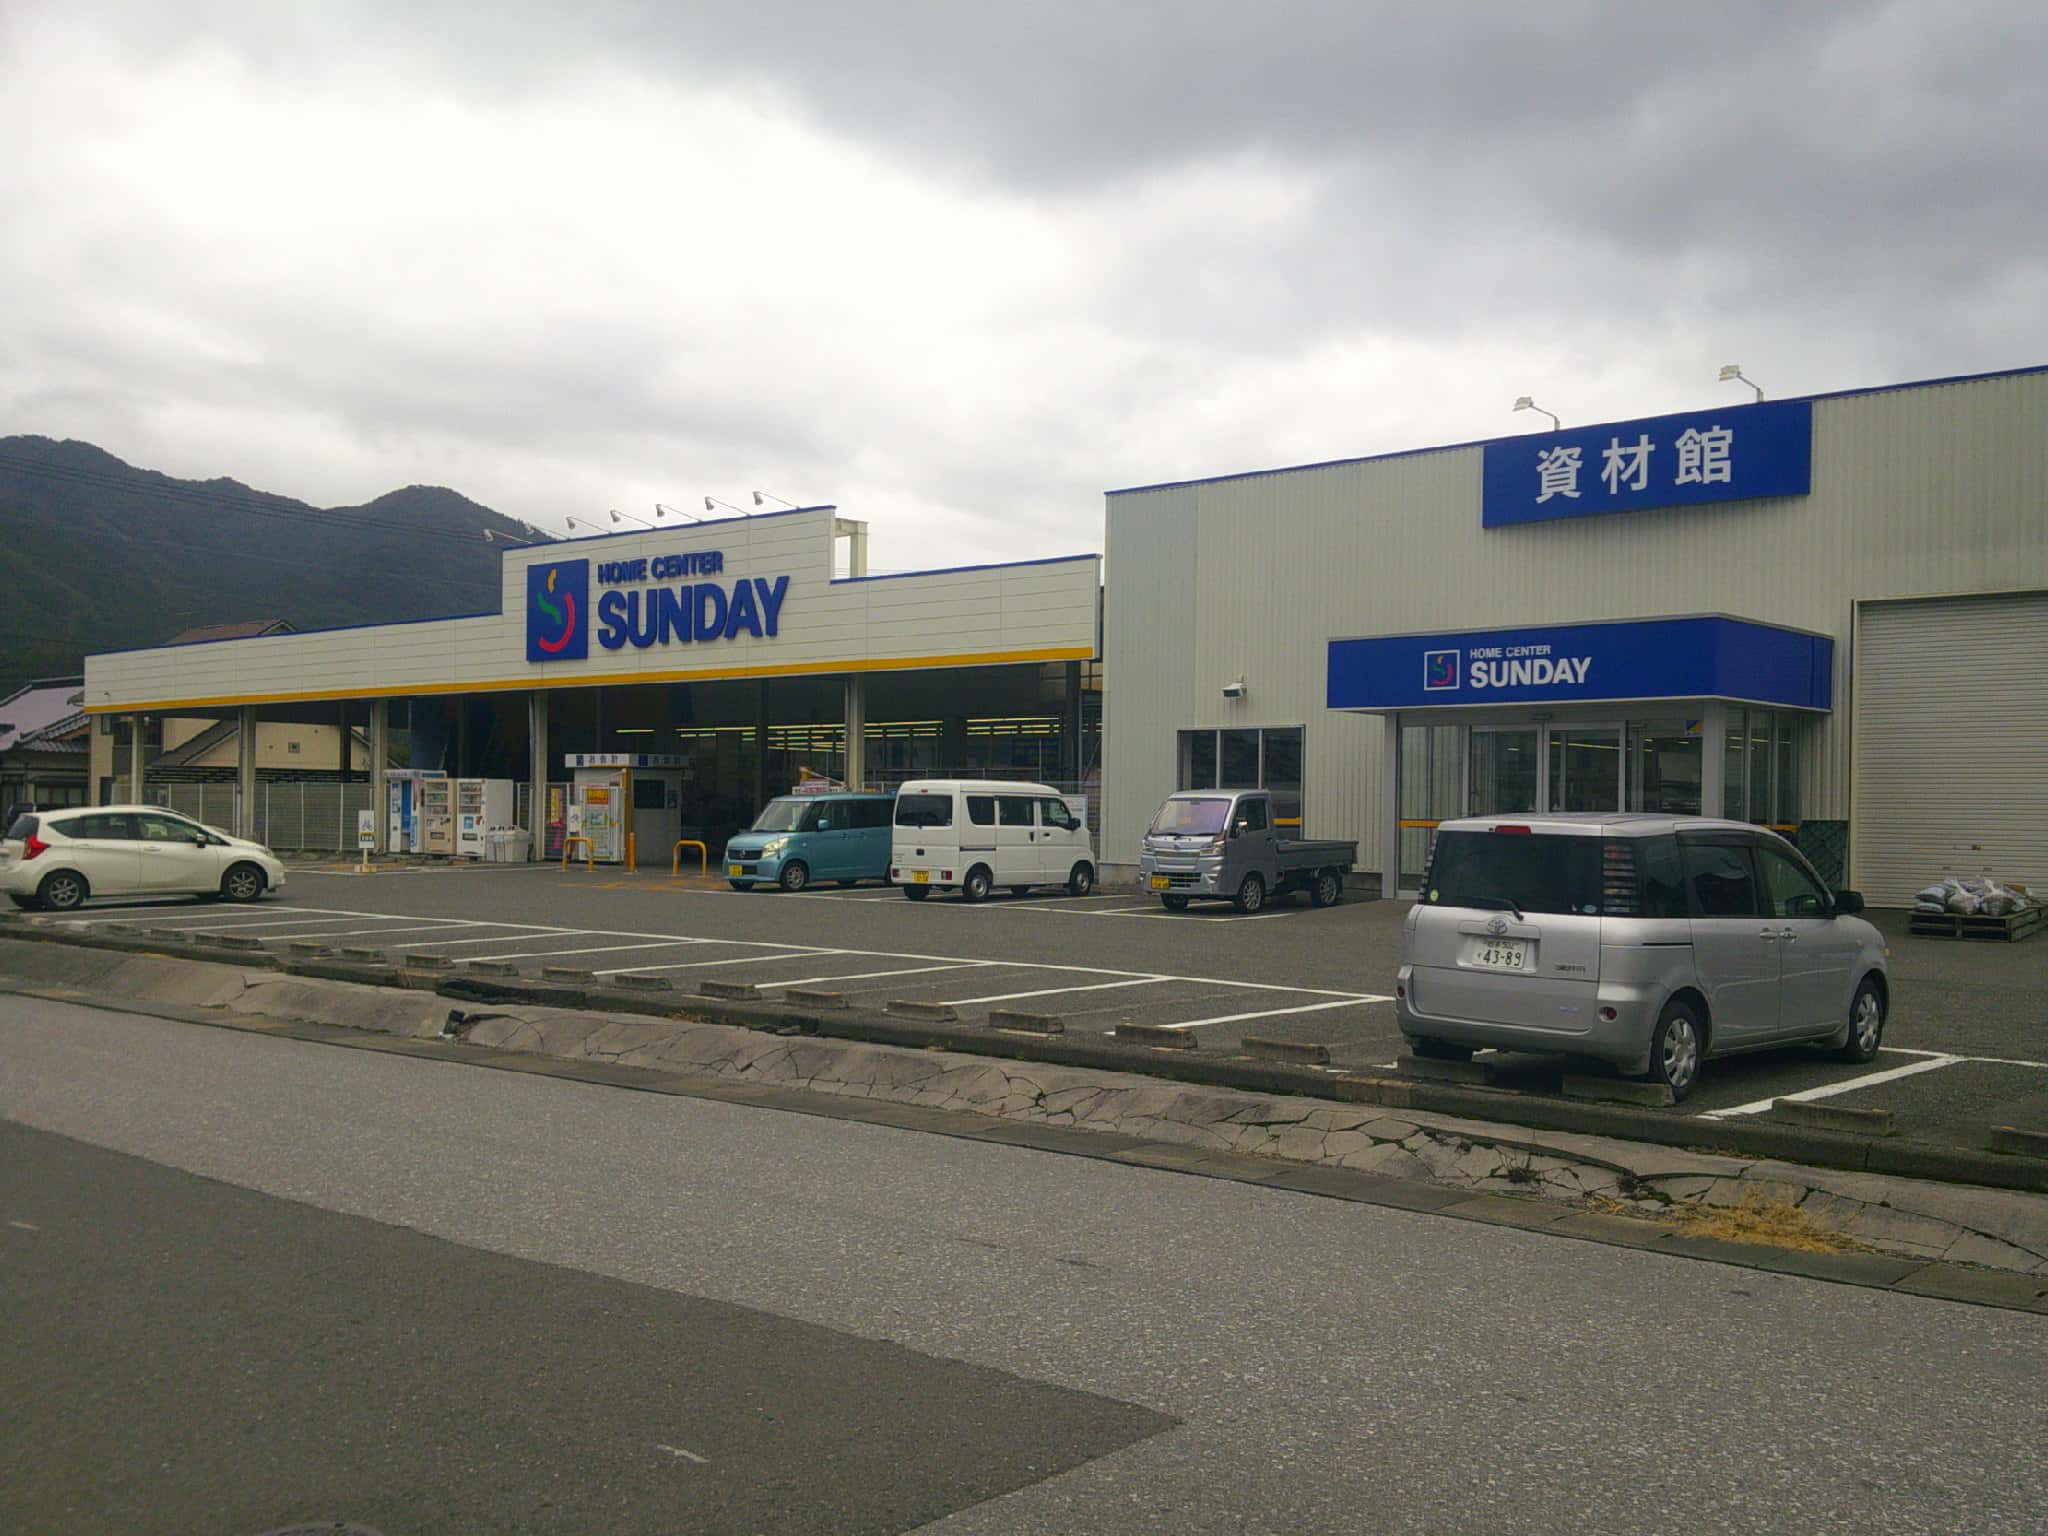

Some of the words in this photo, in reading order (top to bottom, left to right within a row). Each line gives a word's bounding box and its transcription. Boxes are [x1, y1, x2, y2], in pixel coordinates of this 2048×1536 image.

[1536, 425, 1733, 503] 資材館
[598, 558, 647, 584] HOME
[651, 551, 724, 580] CENTER
[598, 575, 790, 649] SUNDAY
[1470, 648, 1502, 659] HOME
[1506, 645, 1551, 657] CENTER
[1470, 657, 1592, 688] SUNDAY
[1483, 949, 1522, 967] 43-89
